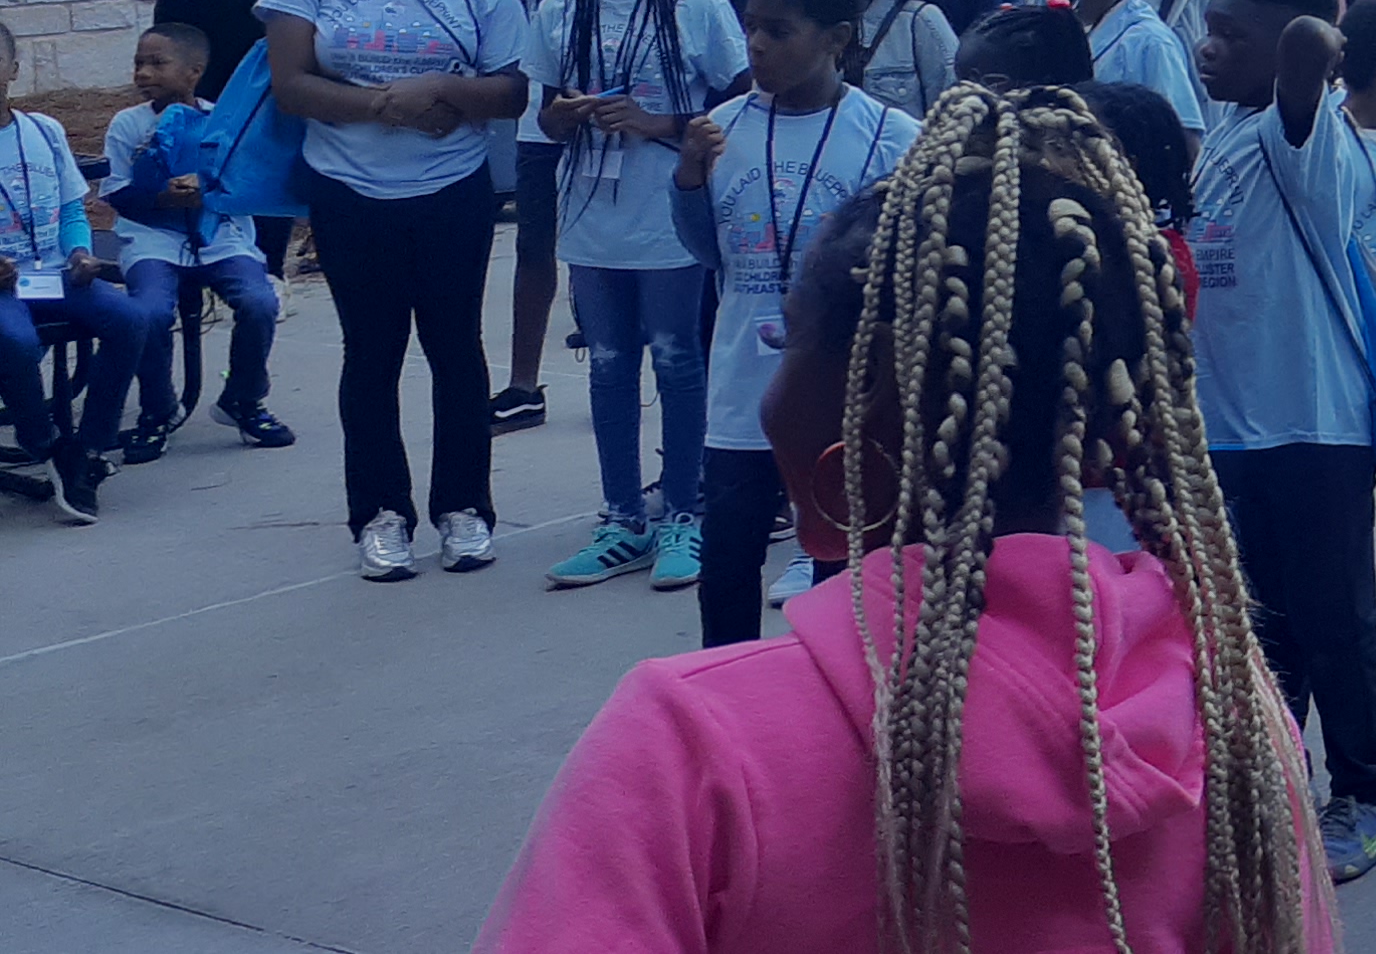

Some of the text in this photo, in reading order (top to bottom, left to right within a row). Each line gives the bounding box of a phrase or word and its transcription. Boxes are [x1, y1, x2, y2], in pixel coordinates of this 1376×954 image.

[601, 24, 625, 33] THE
[719, 195, 737, 224] YOU
[735, 167, 761, 195] LAID
[1196, 248, 1236, 260] EMPIRE
